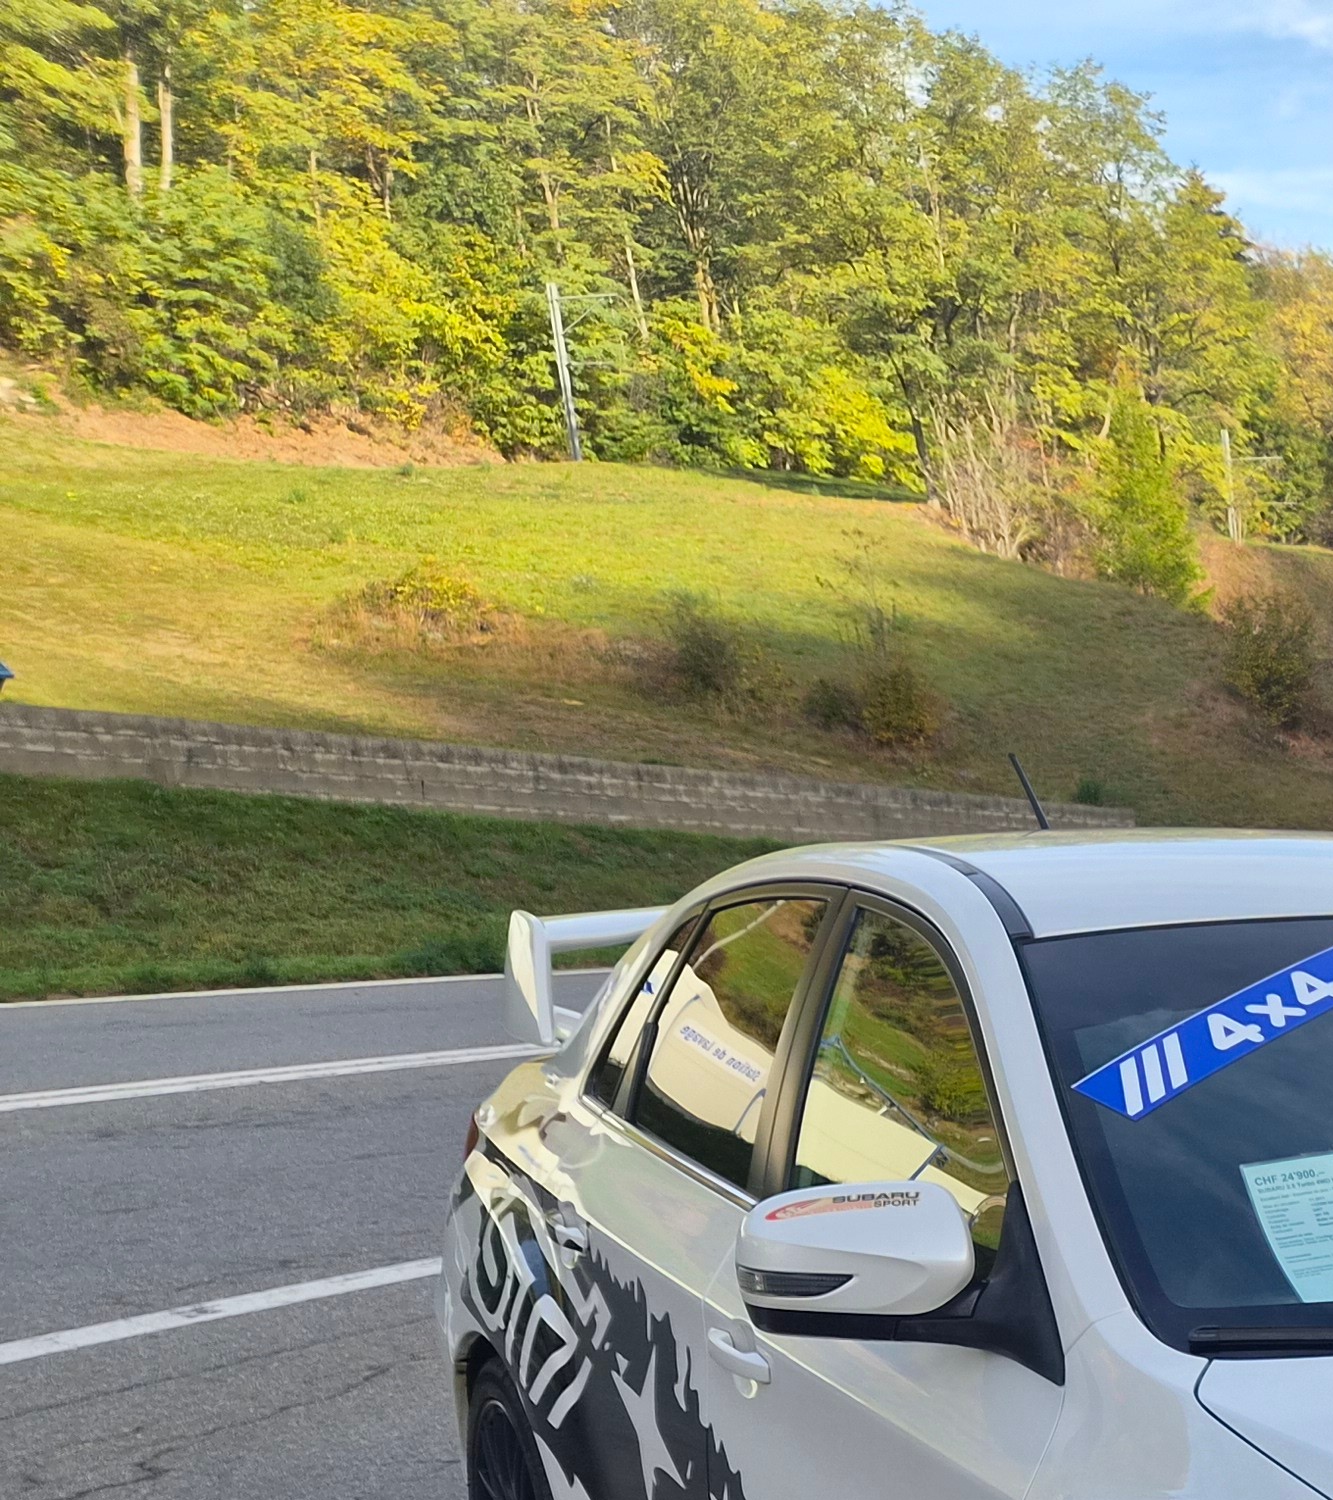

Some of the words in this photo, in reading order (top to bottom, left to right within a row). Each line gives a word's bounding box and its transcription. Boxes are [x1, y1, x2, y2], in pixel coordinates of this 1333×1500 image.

[1254, 1175, 1277, 1186] CHF
[832, 1191, 920, 1204] SUBARU
[873, 1199, 919, 1208] SPORT
